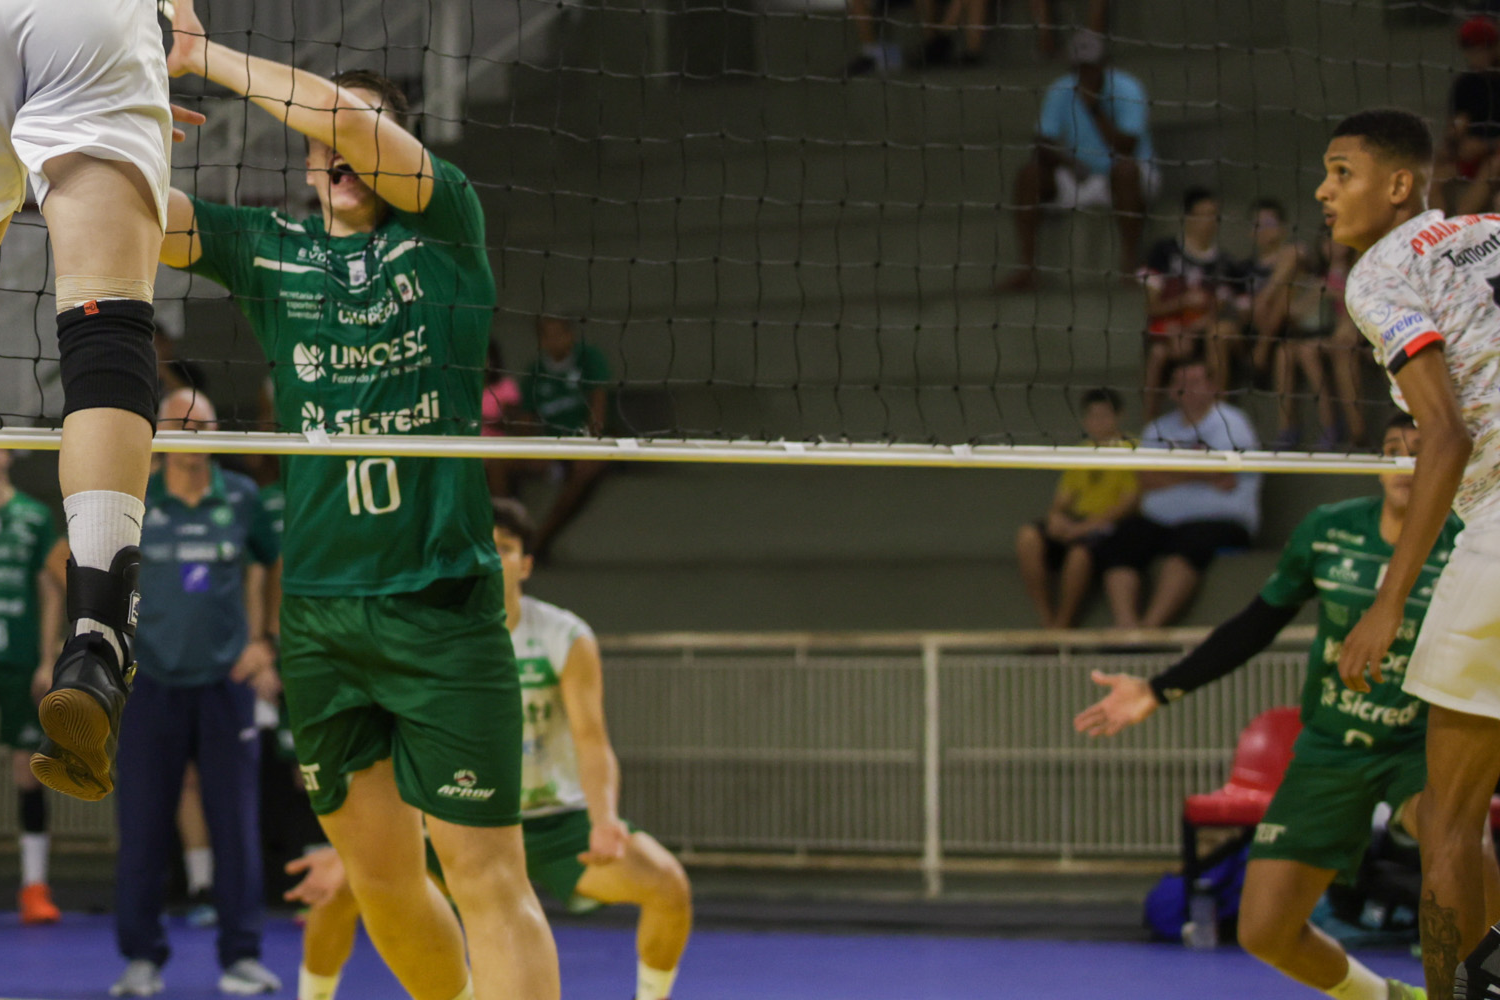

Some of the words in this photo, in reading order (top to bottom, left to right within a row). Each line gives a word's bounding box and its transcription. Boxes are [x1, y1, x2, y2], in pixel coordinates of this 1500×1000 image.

[335, 390, 440, 435] Sicredi
[346, 458, 402, 516] 10
[437, 784, 495, 799] APROV
